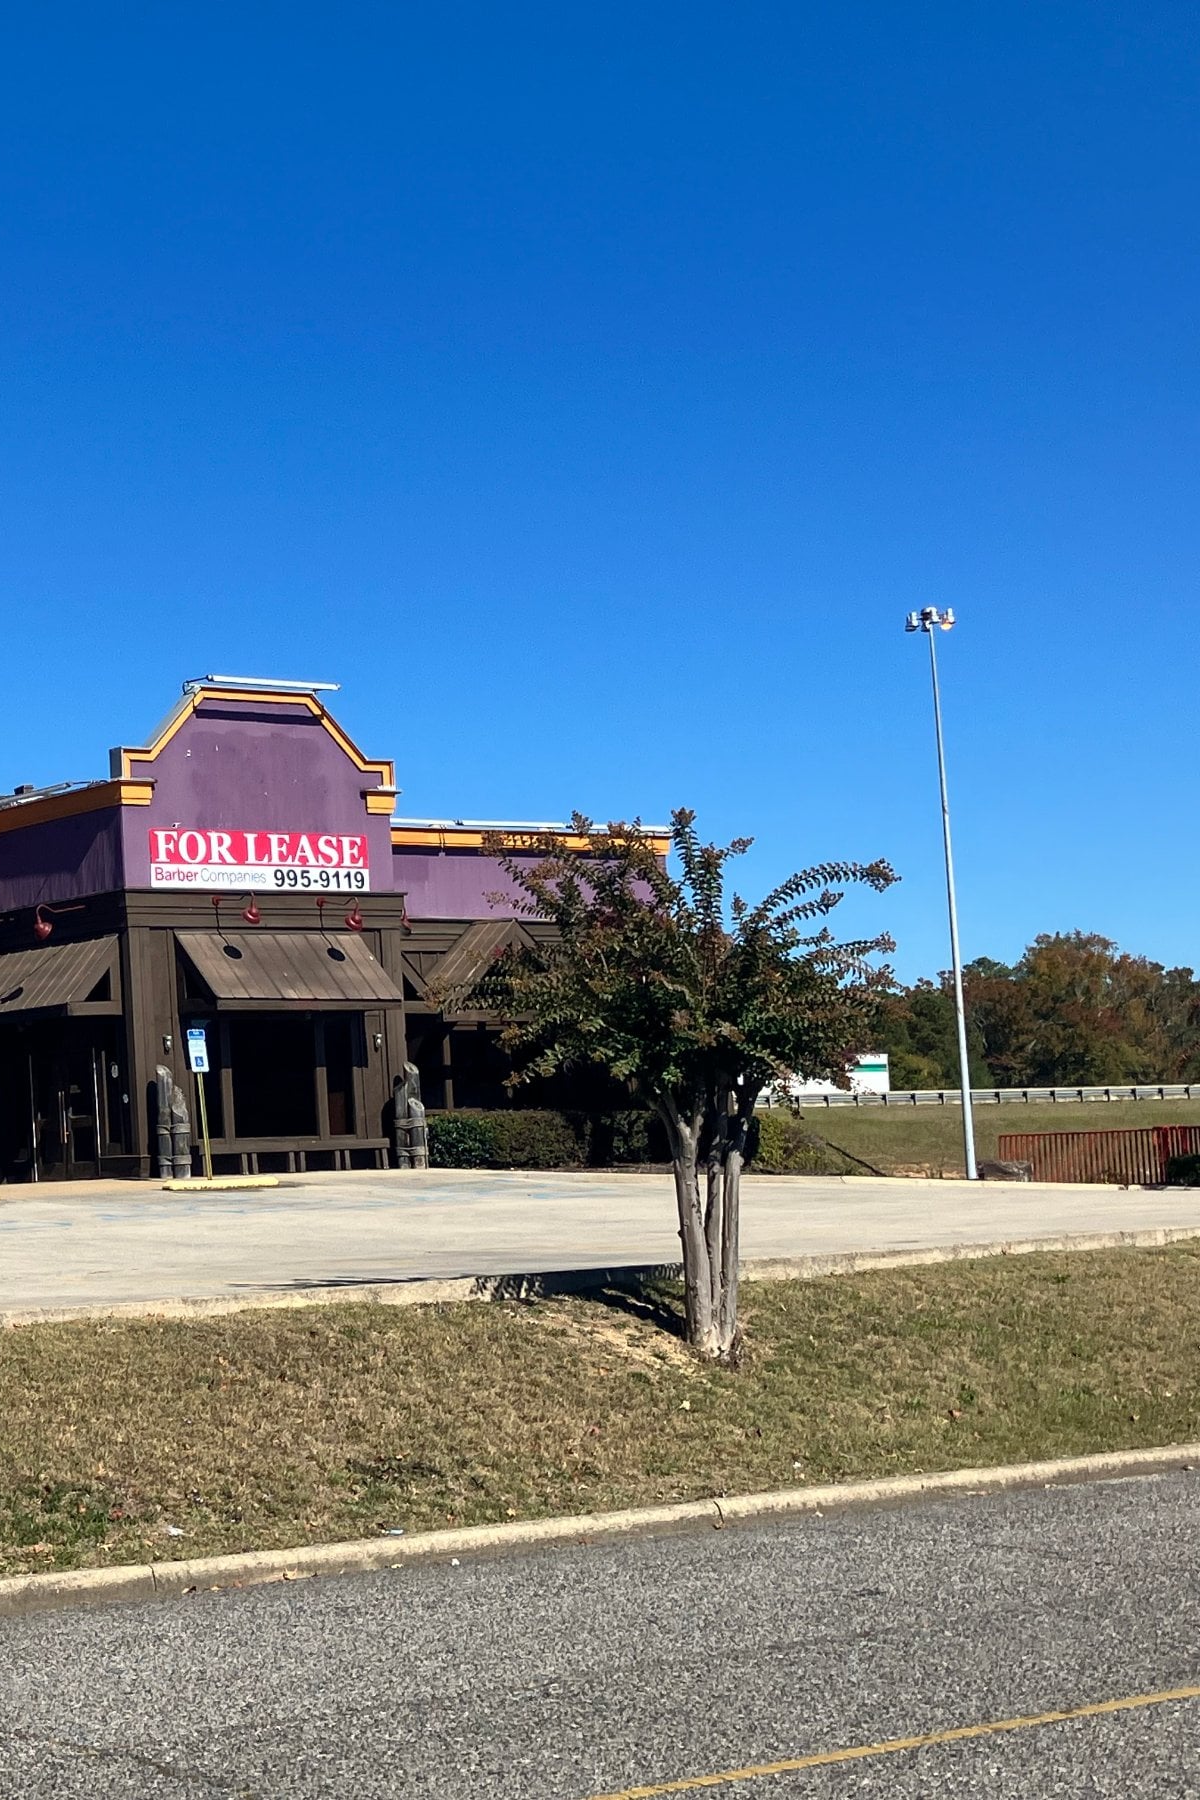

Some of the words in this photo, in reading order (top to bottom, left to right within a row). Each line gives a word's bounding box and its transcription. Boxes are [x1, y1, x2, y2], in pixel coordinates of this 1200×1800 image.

[154, 830, 237, 864] FOR
[243, 832, 363, 868] LEASE
[154, 866, 198, 882] Barber
[200, 867, 267, 885] Companies
[273, 869, 365, 889] 995-9119
